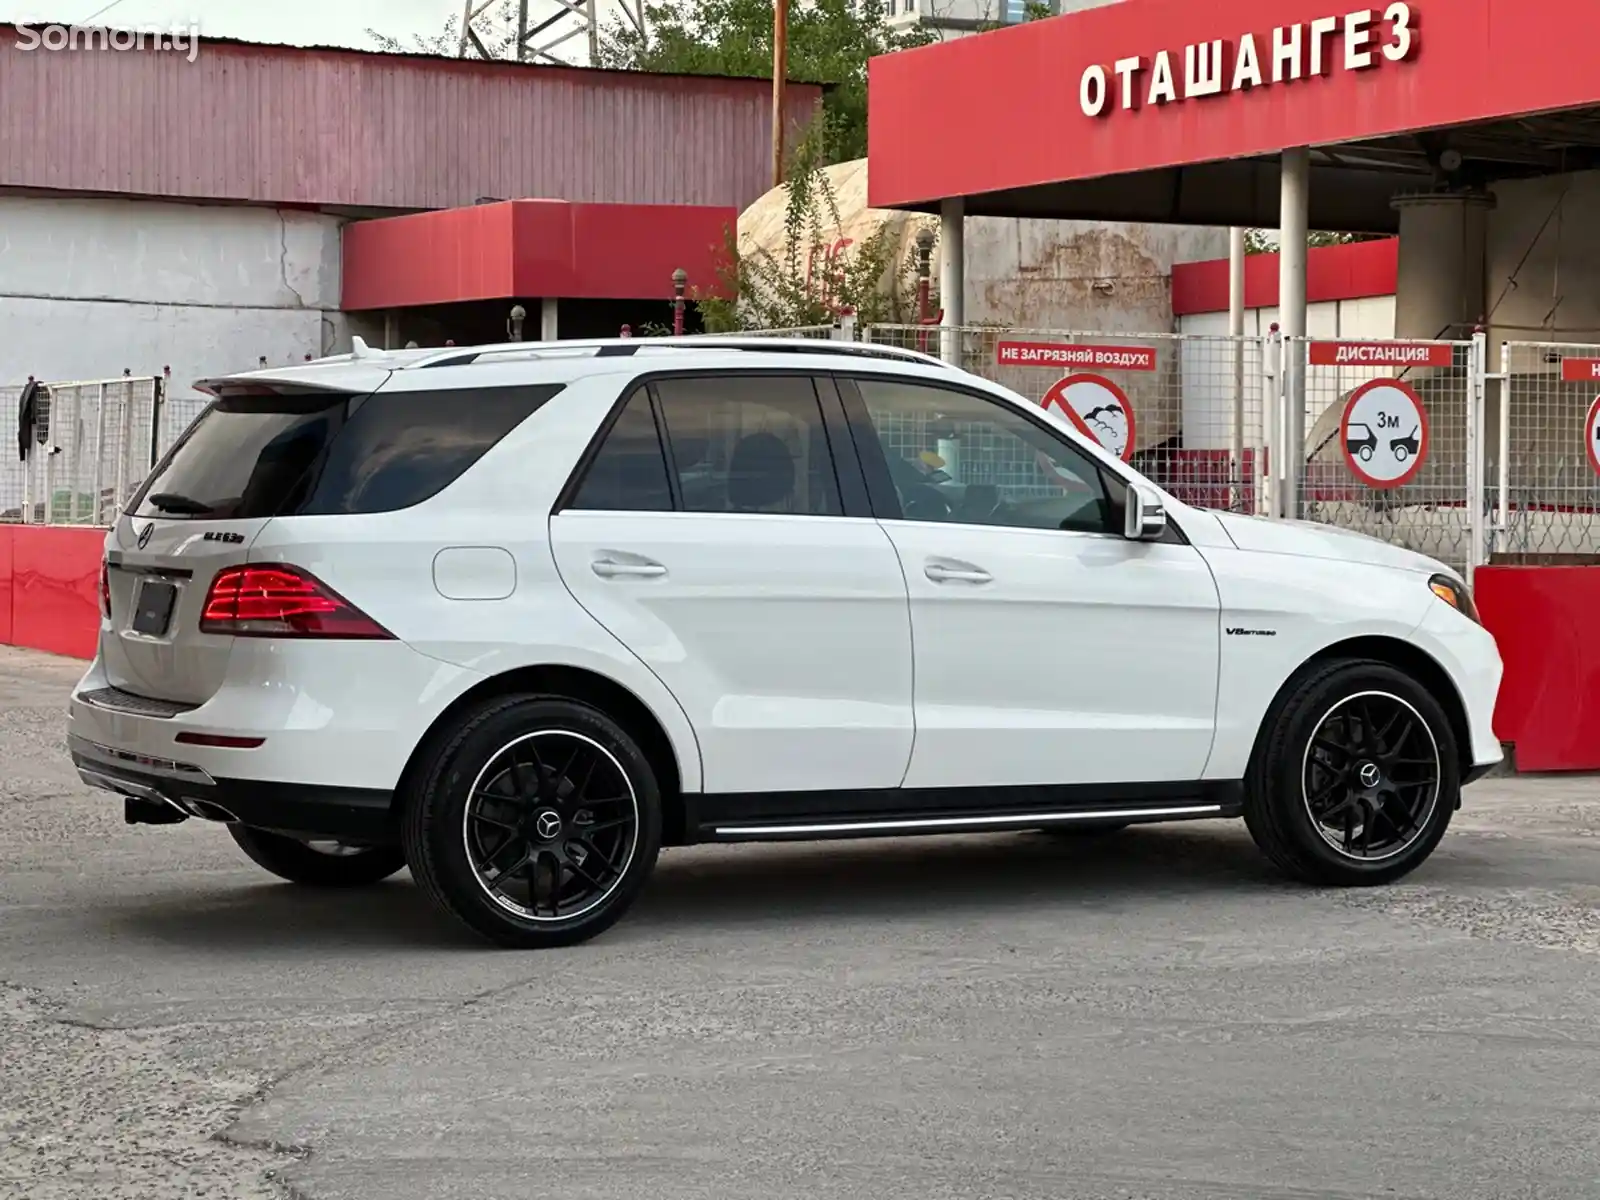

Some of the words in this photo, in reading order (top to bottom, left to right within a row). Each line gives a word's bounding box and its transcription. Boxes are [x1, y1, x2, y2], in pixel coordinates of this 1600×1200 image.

[1079, 2, 1412, 117] ОТАШАНГЕЗ
[1001, 347, 1019, 360] НЕ
[1021, 348, 1093, 363] ЗАГРЯЗНЯЙ
[1095, 353, 1149, 366] ВОЗДУХ!
[1335, 346, 1430, 362] ДИСТАНЦИЯ!
[1376, 411, 1400, 429] 3м
